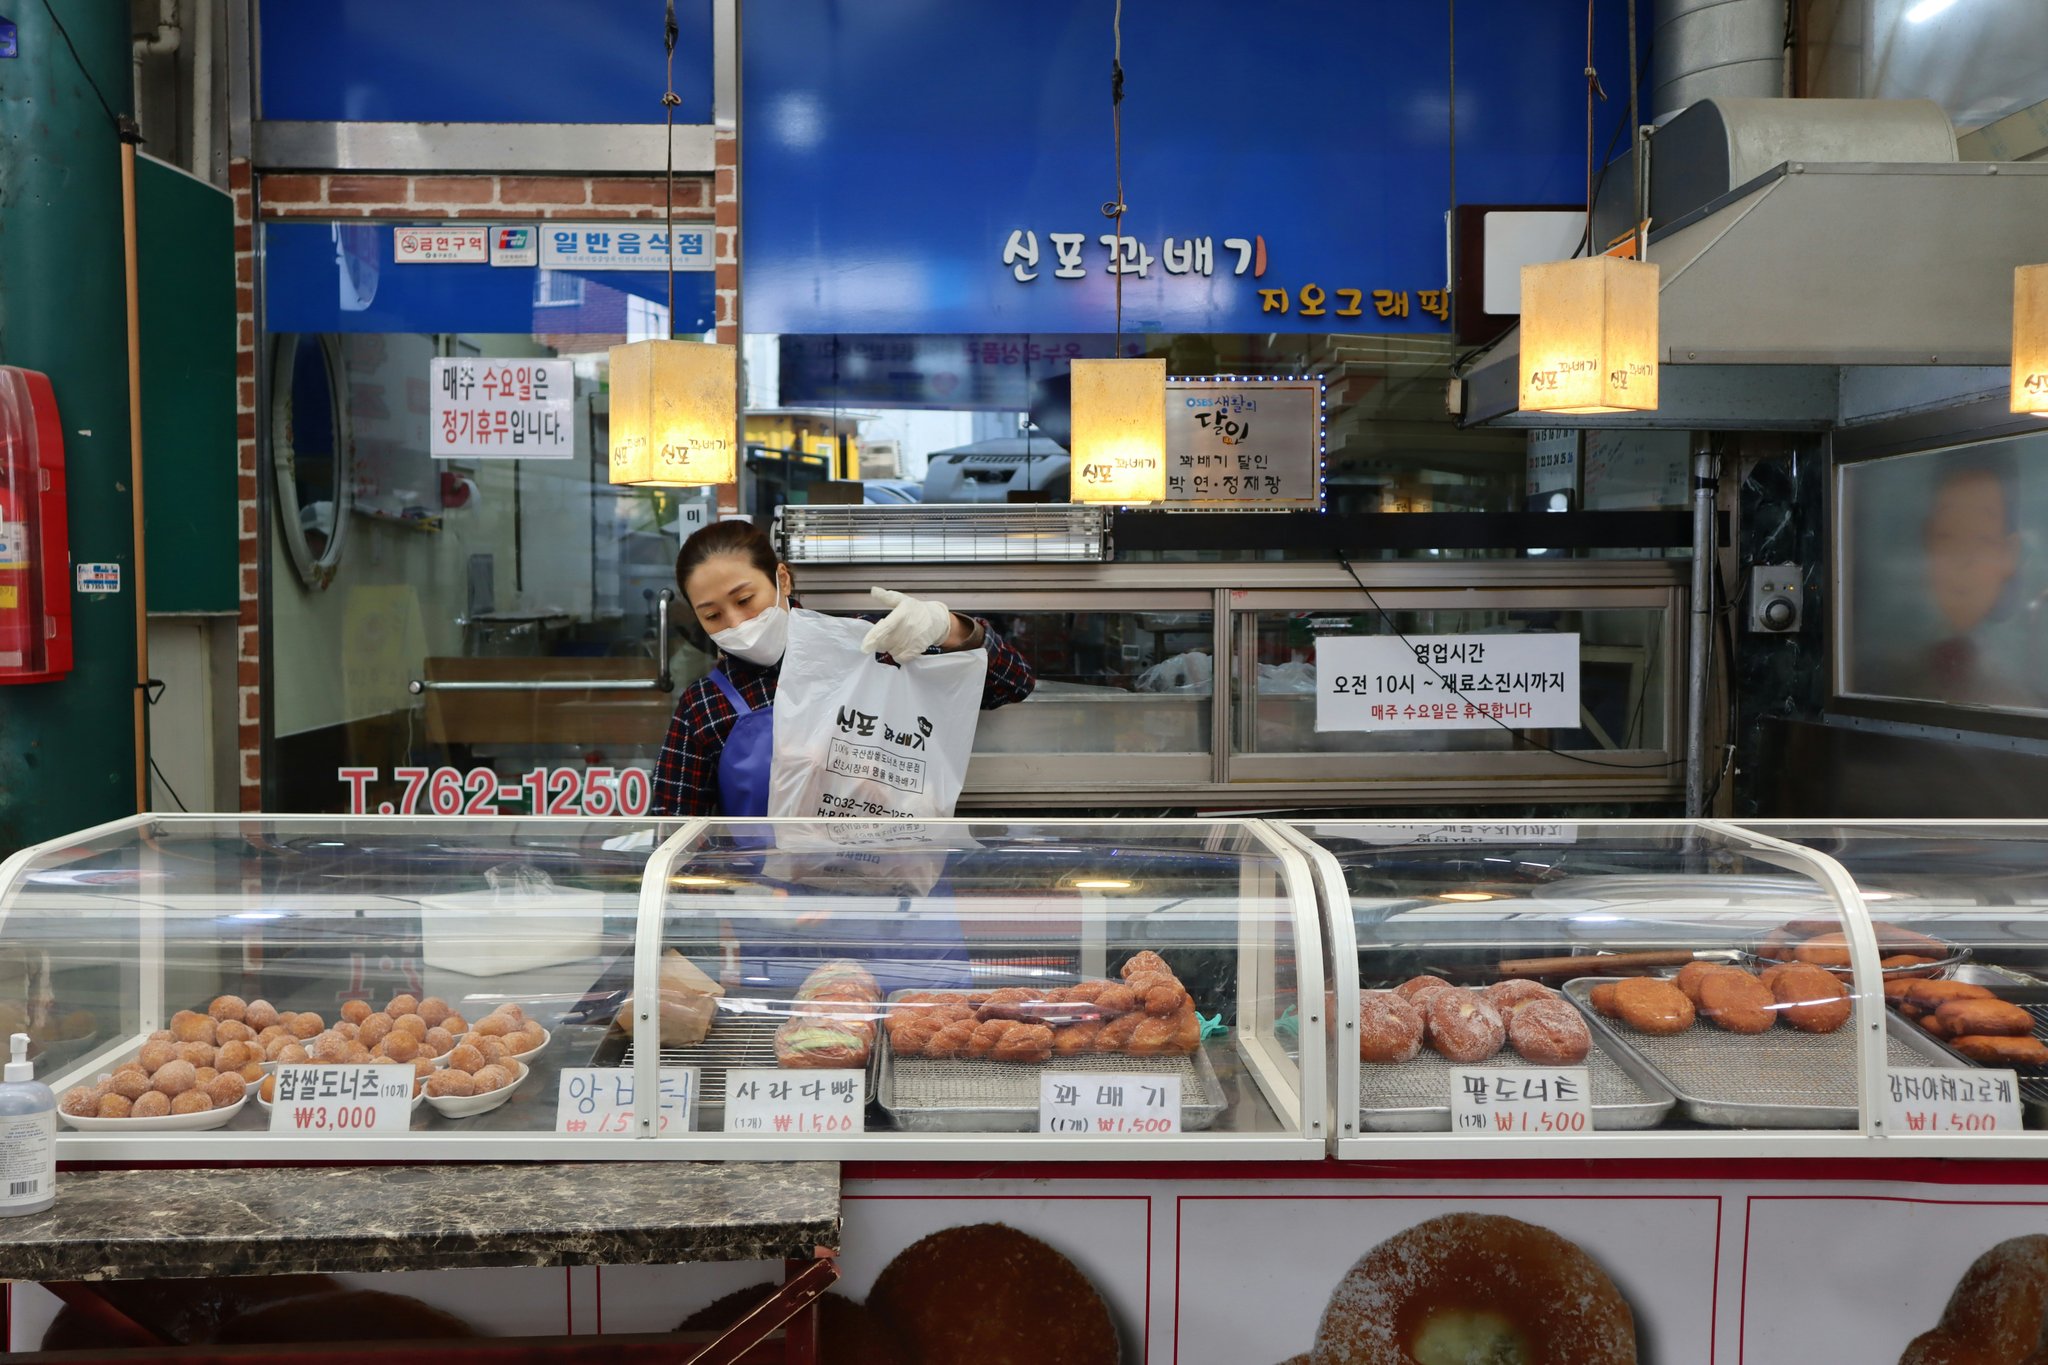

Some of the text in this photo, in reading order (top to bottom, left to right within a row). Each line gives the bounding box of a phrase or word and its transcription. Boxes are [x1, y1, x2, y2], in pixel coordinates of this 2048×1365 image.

[420, 237, 482, 251] 금연구역
[554, 232, 703, 255] 일반음식점
[1258, 283, 1451, 321] 지오그래픽
[1559, 359, 1598, 374] 꽈배기
[443, 366, 549, 401] 매주 수요일은
[1531, 370, 1559, 392] 신포
[1610, 370, 1629, 390] 신포
[1215, 394, 1257, 413] 생활의
[442, 409, 564, 445] 정기휴무입니다.
[1195, 410, 1249, 445] 달인
[661, 444, 690, 465] 신포
[689, 439, 726, 450] 꽈배기
[1082, 463, 1113, 484] 신포
[1115, 457, 1156, 469] 꽈배기
[1180, 455, 1268, 470] 꽈배기 달인
[1415, 642, 1485, 664] 영업시간
[1333, 674, 1368, 695] 오전
[1376, 673, 1415, 695] 10시
[1440, 671, 1565, 694] 재료소진시까지
[836, 705, 879, 737] 신포
[1371, 702, 1533, 720] 매주 수요일은 휴무합니다
[338, 766, 652, 815] T.762-1250
[280, 1069, 408, 1101] 찹쌀도너츠 (10개)
[736, 1078, 858, 1103] 사라다빵
[1053, 1084, 1165, 1108] 꽈배기
[1462, 1075, 1579, 1104] 팥도너츠
[1887, 1074, 2012, 1103] 감자야채고로케
[293, 1106, 376, 1131] ₩3,000
[735, 1117, 762, 1129] (1개)
[1050, 1117, 1088, 1132] (1개)
[1459, 1114, 1487, 1128] (1개)
